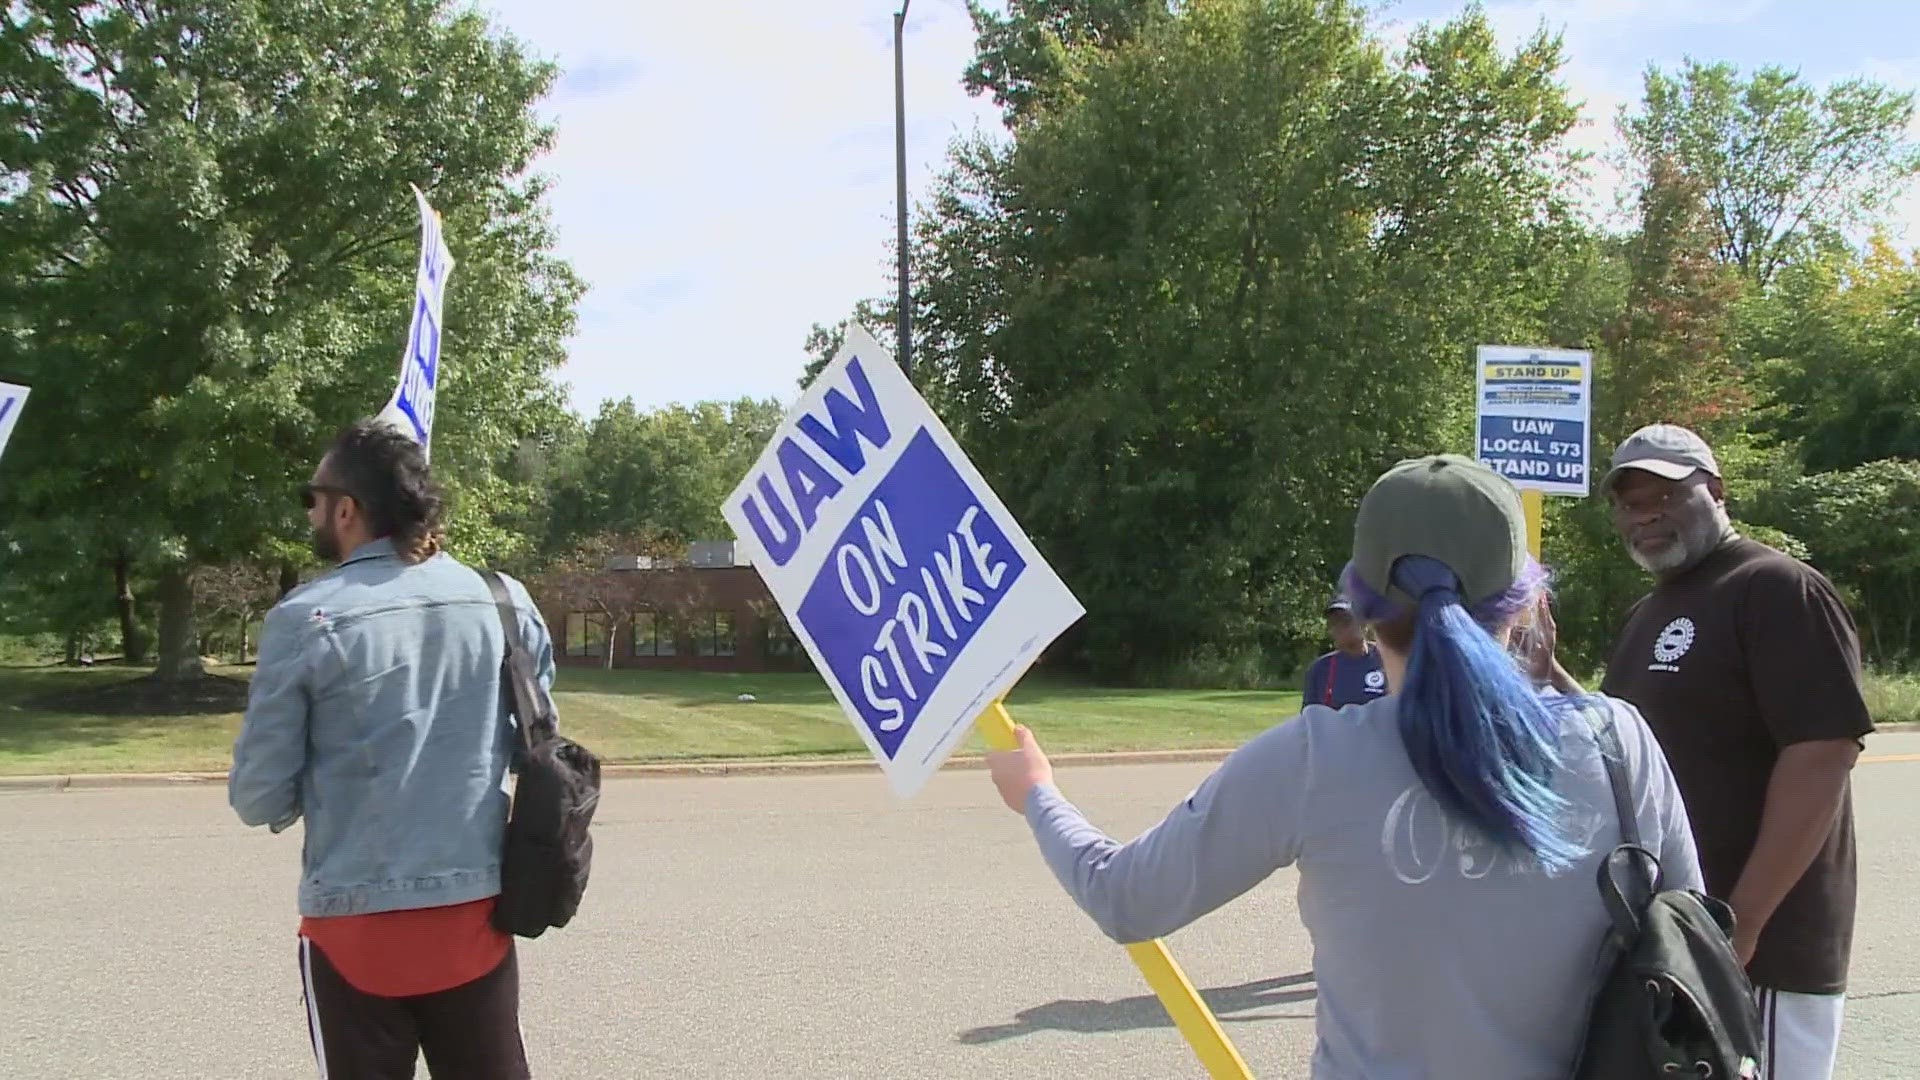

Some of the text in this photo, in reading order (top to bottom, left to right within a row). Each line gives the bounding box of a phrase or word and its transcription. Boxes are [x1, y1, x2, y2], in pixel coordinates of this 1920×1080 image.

[1496, 367, 1570, 377] STAND UP
[1512, 419, 1554, 435] UAW
[1483, 438, 1581, 457] LOCAL 573
[741, 355, 891, 567] UAW
[1556, 461, 1584, 478] UP
[837, 499, 907, 616] ON
[861, 505, 1008, 731] STRIKE
